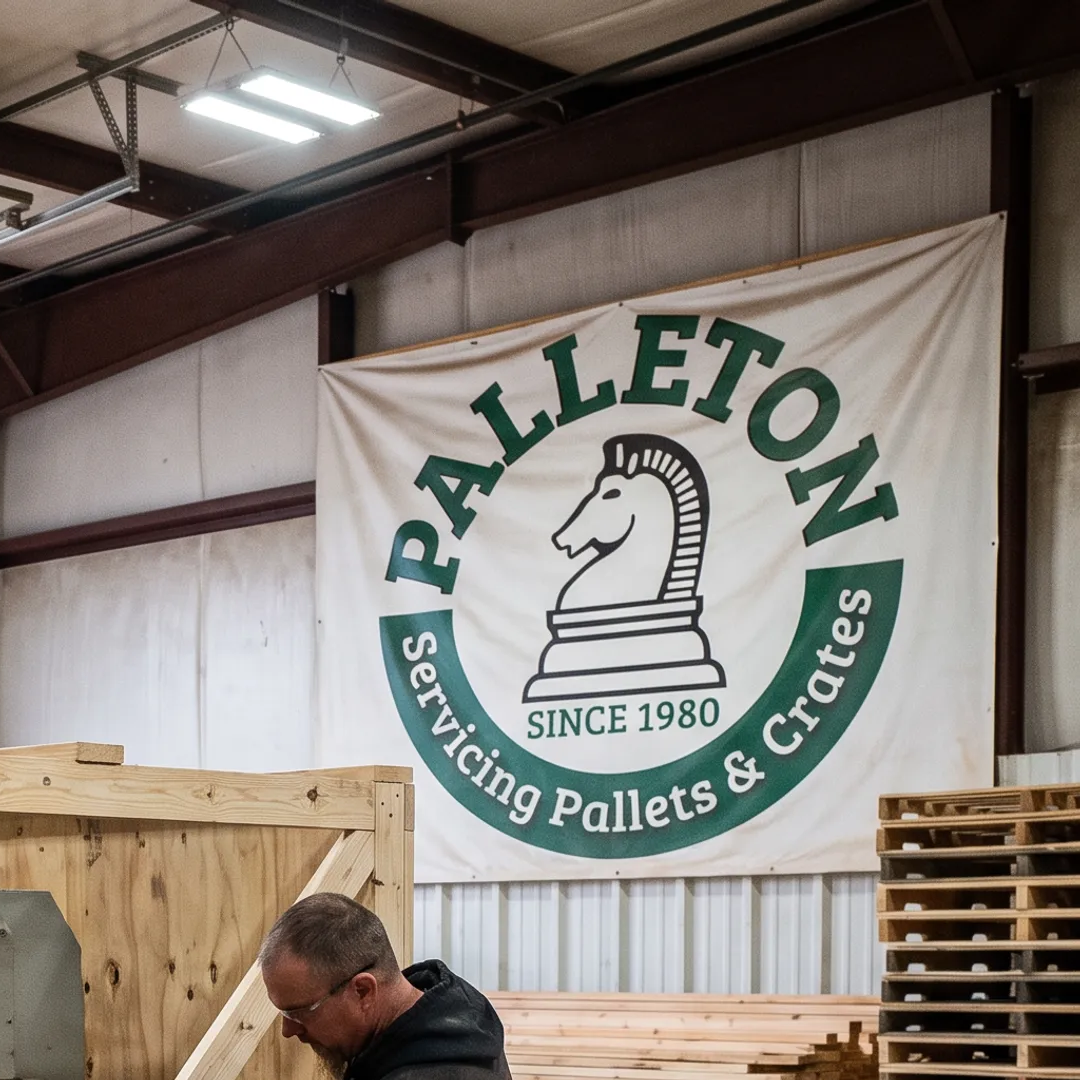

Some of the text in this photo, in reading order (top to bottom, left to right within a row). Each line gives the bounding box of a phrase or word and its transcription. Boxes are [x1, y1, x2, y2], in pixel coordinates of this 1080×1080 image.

[384, 314, 900, 594] PALLETON
[401, 587, 873, 833] Servicing Pallets & Crates
[526, 697, 721, 740] SINCE 1980
